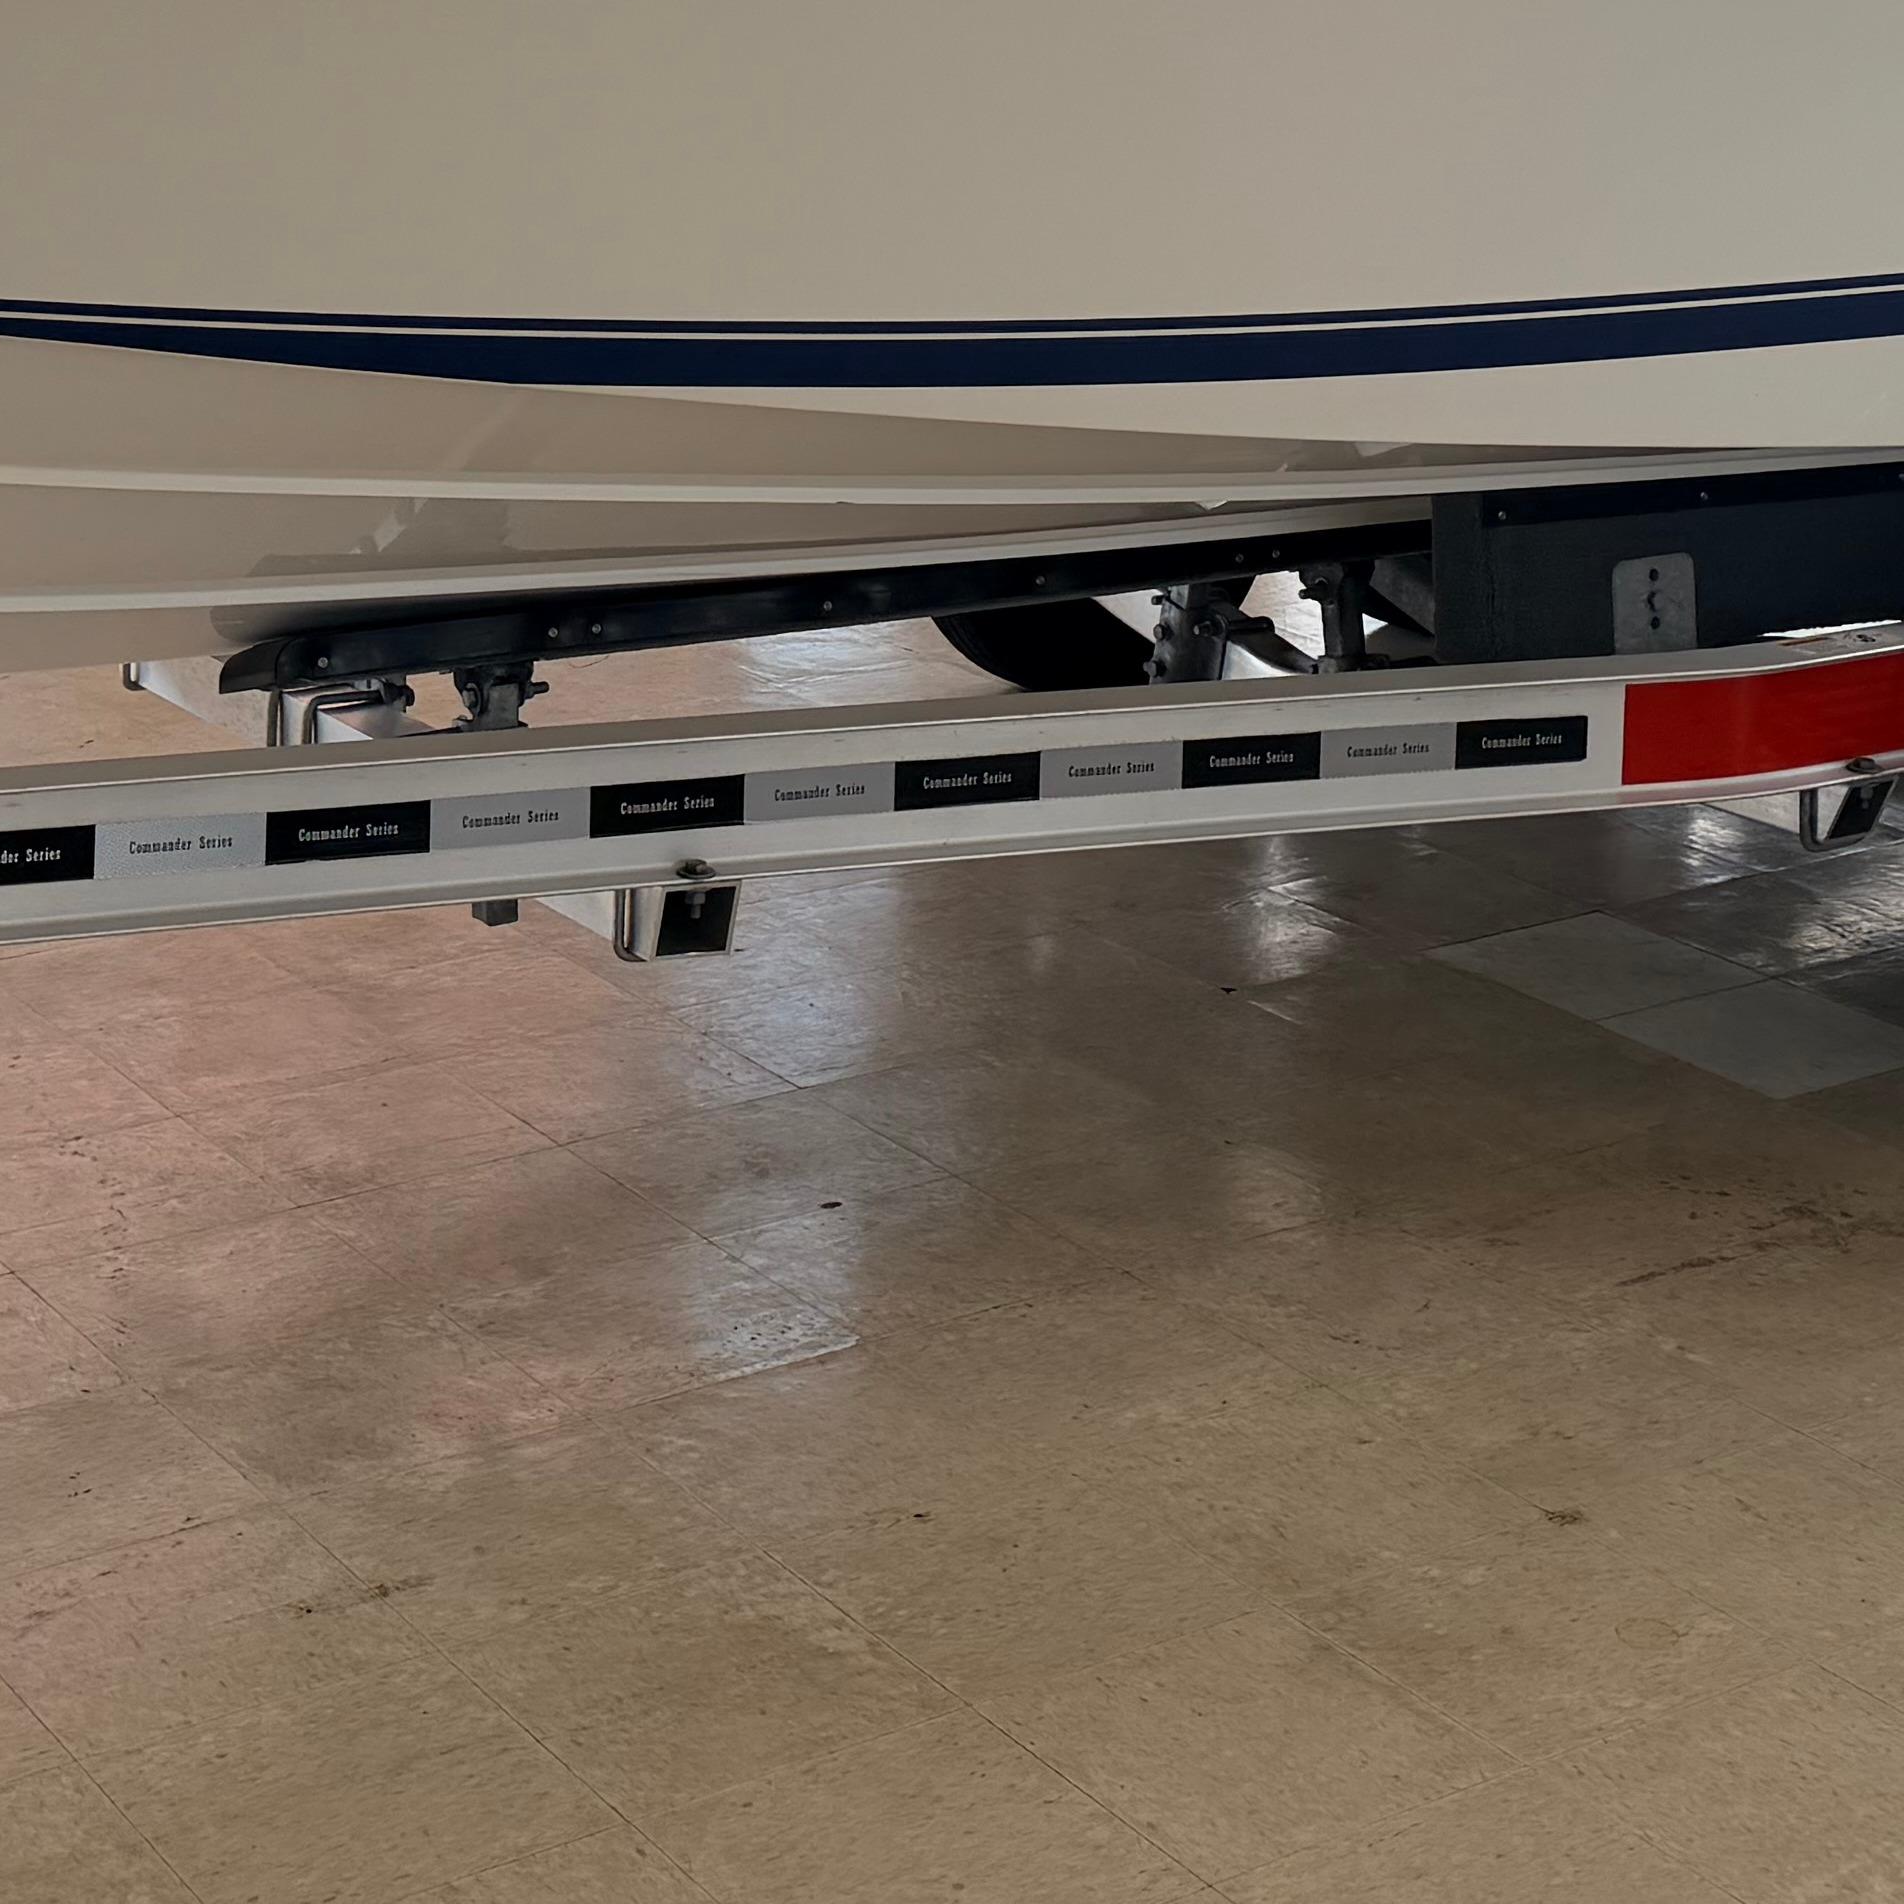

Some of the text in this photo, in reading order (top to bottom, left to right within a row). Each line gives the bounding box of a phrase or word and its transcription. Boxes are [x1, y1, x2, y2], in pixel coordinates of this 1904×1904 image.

[1345, 741, 1430, 759] Commander Series
[1480, 732, 1563, 750] Commander Series
[1068, 759, 1156, 779] Commander Series
[1208, 750, 1295, 769] Commander Series
[922, 770, 1013, 790] Commander Series
[773, 782, 866, 802] Commander Series
[620, 795, 715, 816] Commander Series
[461, 808, 560, 830] Commander Series
[298, 822, 400, 843] Commander Series
[128, 834, 234, 855] Commander Series
[25, 847, 62, 863] Series
